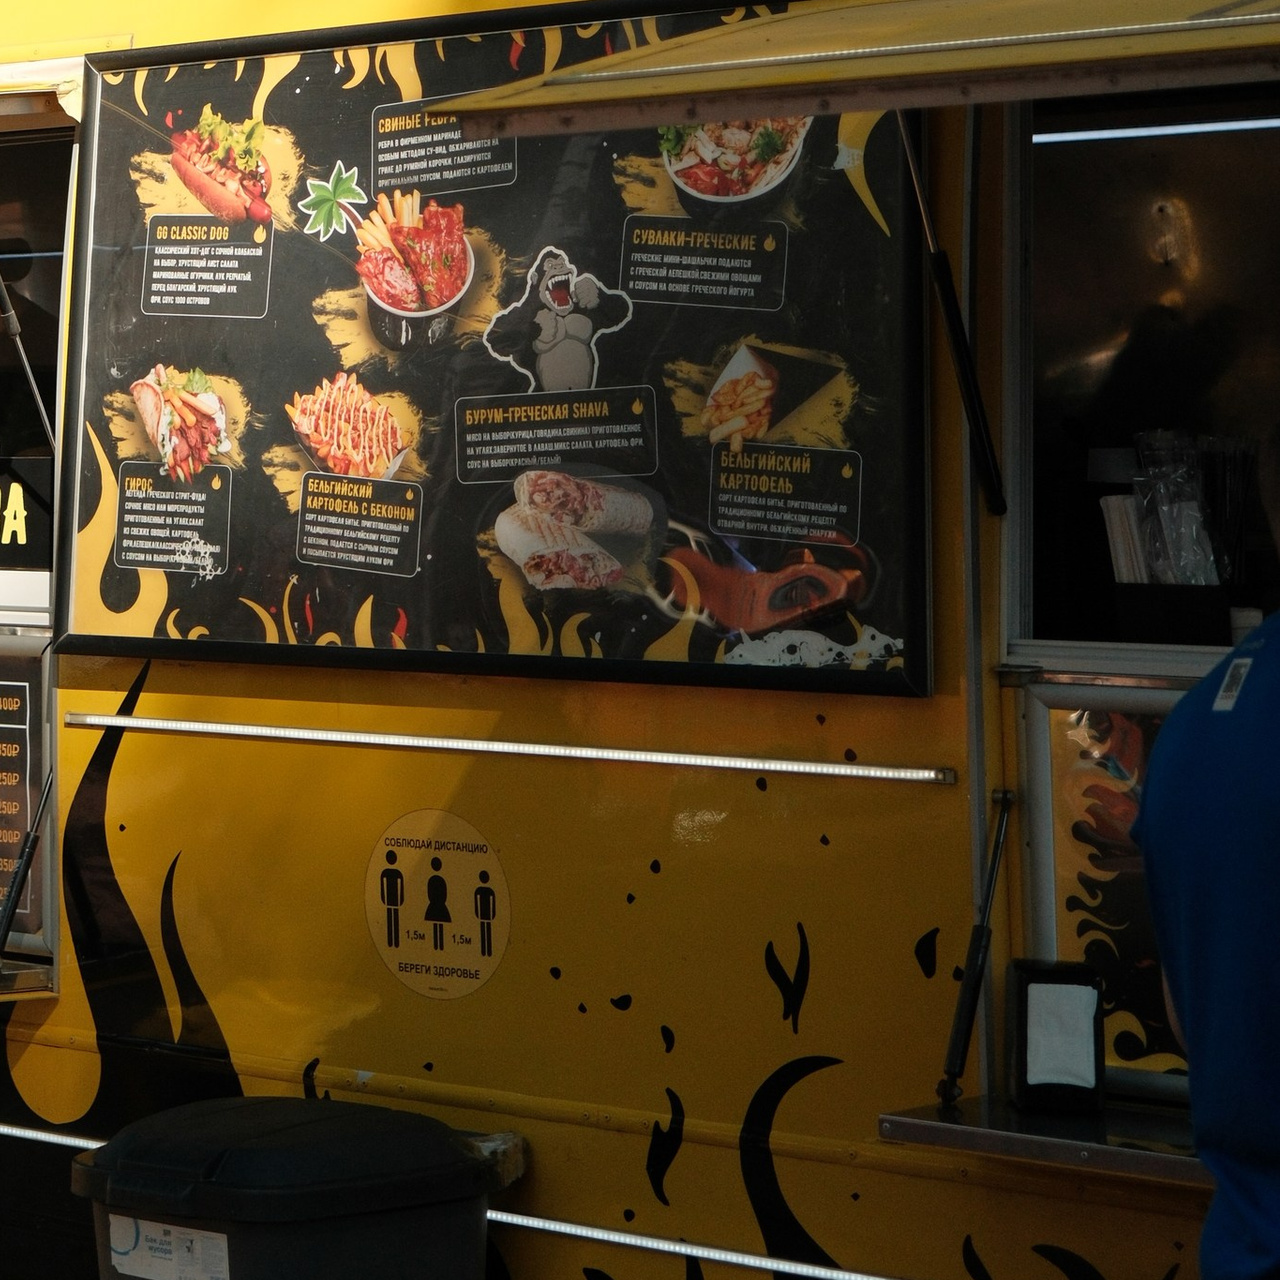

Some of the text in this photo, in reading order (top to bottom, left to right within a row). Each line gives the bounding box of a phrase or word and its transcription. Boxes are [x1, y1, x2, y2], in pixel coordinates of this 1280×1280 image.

[379, 114, 421, 133] СВИНЫЕ
[378, 130, 461, 149] РЕБРА В ФИРМЕННОМ МАРИНАДЕ
[378, 152, 399, 162] ОСОБЫМ
[401, 148, 425, 159] МЕТОДОМ
[449, 139, 490, 152] ОБЖАРИВАЮТСЯ
[492, 138, 499, 146] НА
[395, 164, 402, 173] ДО
[404, 160, 427, 171] РУМЯНОЙ
[454, 152, 491, 164] ГЛАЗИРУЮТСЯ
[443, 168, 471, 180] ПОДАЮТСЯ
[477, 163, 512, 174] КАРТОФЕЛЕМ
[157, 226, 229, 240] GG CLASSIC DOG
[633, 229, 757, 251] СУВЛАКИ-ГРЕЧЕСКИЕ
[179, 259, 206, 268] ХРУСТЯЩИЙ
[631, 253, 751, 268] ГРЕЧЕСКИЕ МИНИ-ШАШЛЫЧКИ ПОДАЮТСЯ
[636, 267, 667, 277] ГРЕЧЕСКОЙ
[731, 273, 761, 283] ОВОЩАМИ
[152, 284, 165, 292] ПЕРЕЦ
[198, 283, 226, 293] ХРУСТЯЩИЙ
[629, 281, 754, 296] И СОУСОМ НА ОСНОВЕ ГРЕЧЕСКОГО ЙОГУРТА
[162, 296, 174, 304] СОУС
[466, 401, 609, 425] БУРУМ-ГРЕЧЕСКАЯ SHAVA
[466, 432, 481, 442] МЯСО
[483, 432, 490, 441] НА
[592, 424, 641, 435] ПРИГОТОВЛЕННОЕ
[467, 446, 474, 455] НА
[528, 443, 532, 452] В
[595, 438, 629, 449] КАРТОФЕЛЬ
[467, 459, 481, 468] СОУС
[482, 459, 489, 468] НА
[721, 450, 811, 473] БЕЛЬГИЙСКИЙ
[125, 478, 152, 491] ГИРОС
[308, 479, 372, 498] БЕЛЬГИЙСКИЙ
[720, 473, 793, 494] КАРТОФЕЛЬ
[307, 496, 415, 520] КАРТОФЕЛЬ С БЕКОНОМ
[385, 838, 488, 854] СОБЛЮДАЙ ДИСТАНЦИЮ
[406, 930, 425, 941] 1,5м
[452, 934, 471, 945] 1,5м
[399, 962, 480, 979] БЕРЕГИ ЗДОРОВЬЕ
